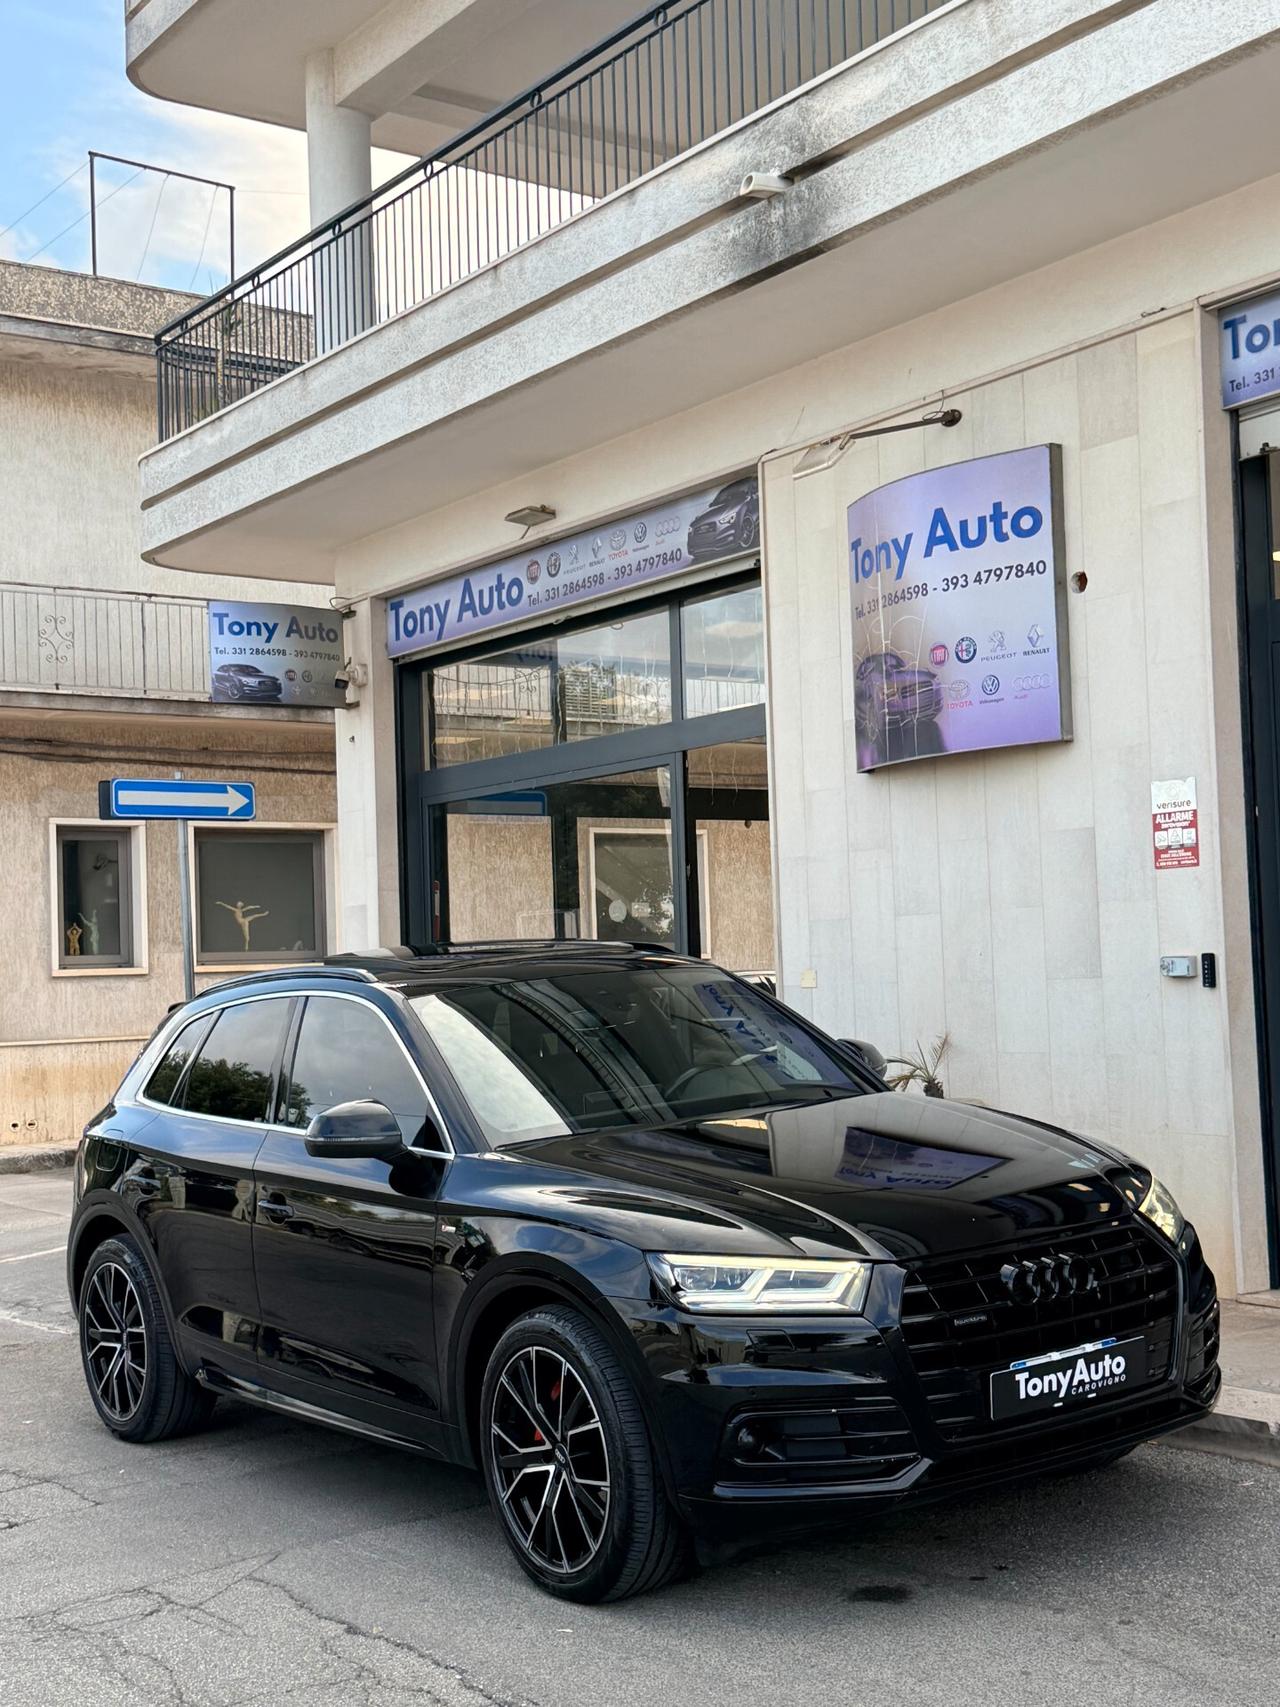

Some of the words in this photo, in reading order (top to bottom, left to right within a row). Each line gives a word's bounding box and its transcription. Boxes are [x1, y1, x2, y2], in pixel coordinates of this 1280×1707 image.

[1229, 376, 1250, 392] Tel.
[1254, 367, 1275, 385] 331
[851, 532, 913, 583] Tony
[923, 501, 1043, 558] Auto
[608, 549, 628, 560] TOYOTA
[527, 594, 543, 607] Tel.
[545, 587, 560, 602] 331
[562, 572, 605, 597] 2864598
[614, 565, 633, 581] 393
[635, 548, 682, 573] 4797840
[881, 582, 929, 608] 2864598
[941, 573, 969, 593] 393
[973, 560, 1047, 585] 4797840
[390, 599, 450, 641] Tony
[457, 573, 524, 623] Auto
[212, 612, 279, 643] Tony
[285, 615, 339, 643] Auto
[214, 647, 229, 656] Tel.
[232, 647, 246, 656] 331
[250, 648, 287, 657] 2864598
[294, 650, 308, 659] 393
[310, 651, 340, 662] 4797840
[981, 652, 1017, 662] PEUGEOT
[1022, 647, 1050, 657] RENAULT
[947, 700, 974, 710] TOYOTA
[1156, 799, 1191, 809] verisure
[1155, 810, 1194, 824] ALLARME
[1015, 1353, 1126, 1400] TonyAuto
[1071, 1373, 1127, 1395] CAROVIGNO
